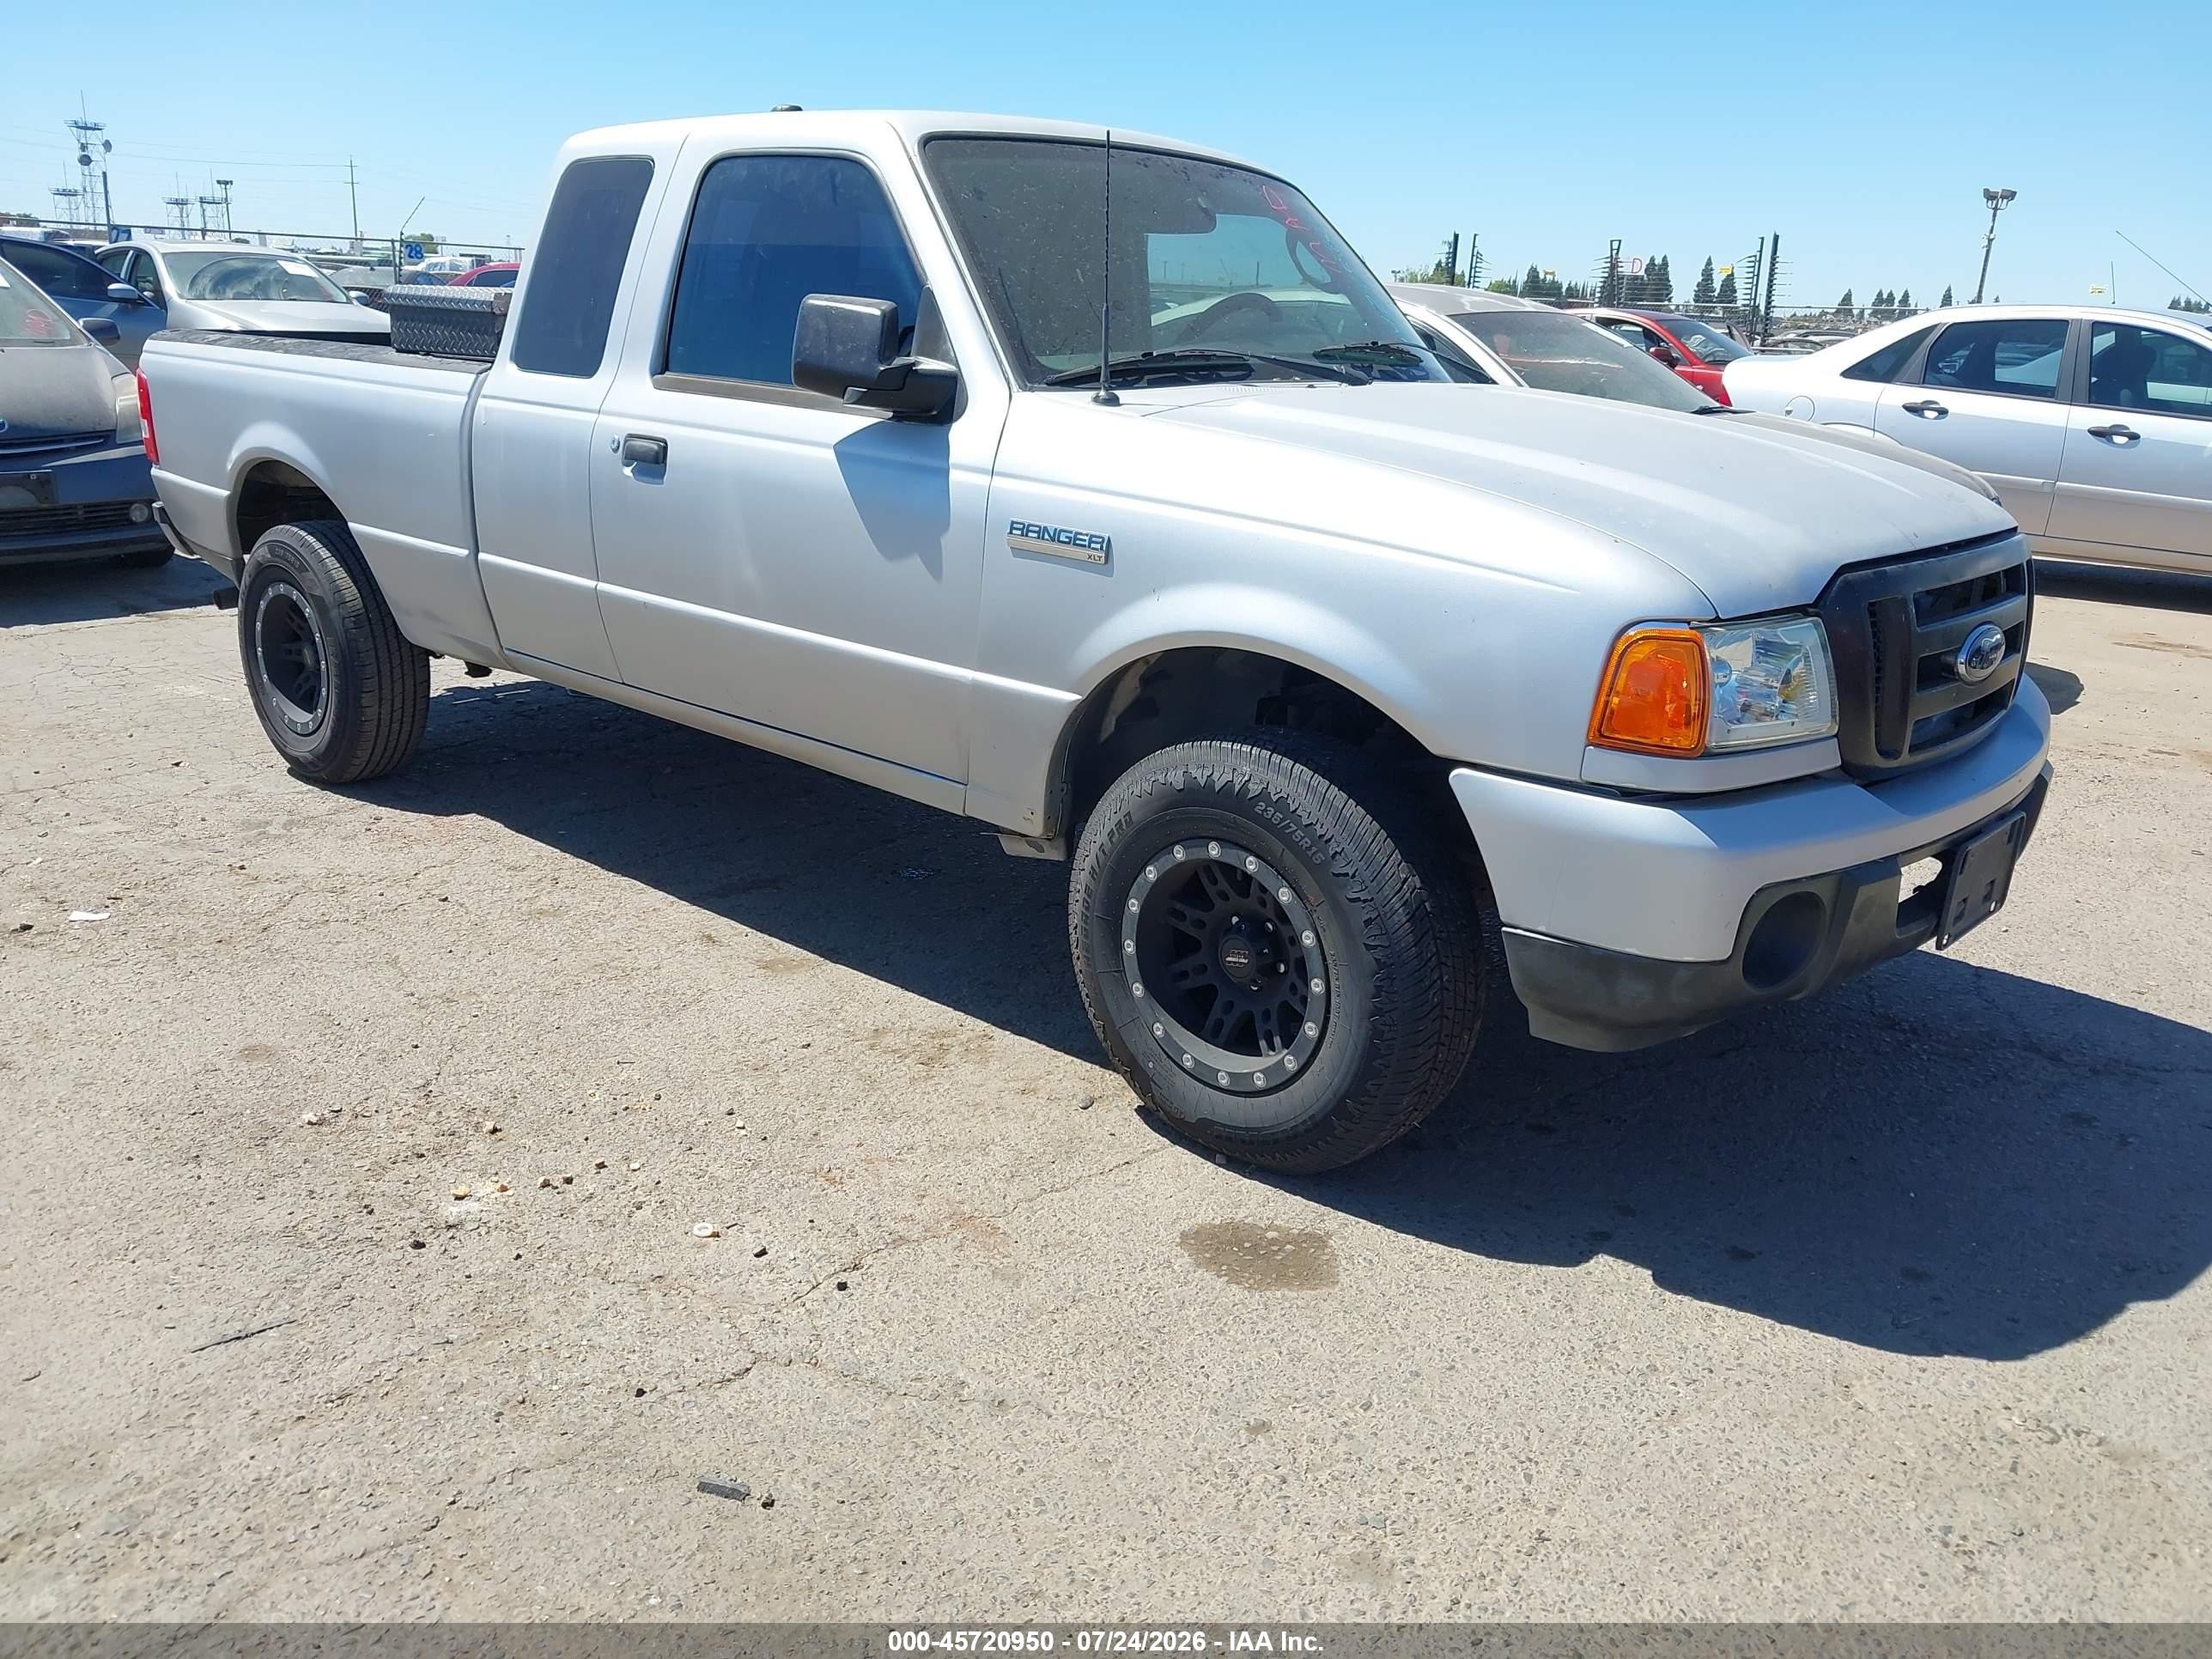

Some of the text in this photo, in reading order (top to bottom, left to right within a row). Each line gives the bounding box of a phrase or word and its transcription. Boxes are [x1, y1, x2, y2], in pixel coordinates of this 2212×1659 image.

[405, 244, 423, 259] 28
[1632, 258, 1643, 274] D
[1008, 519, 1106, 551] RANGER
[1087, 553, 1103, 562] XLT
[1254, 801, 1326, 865] 235/75R15
